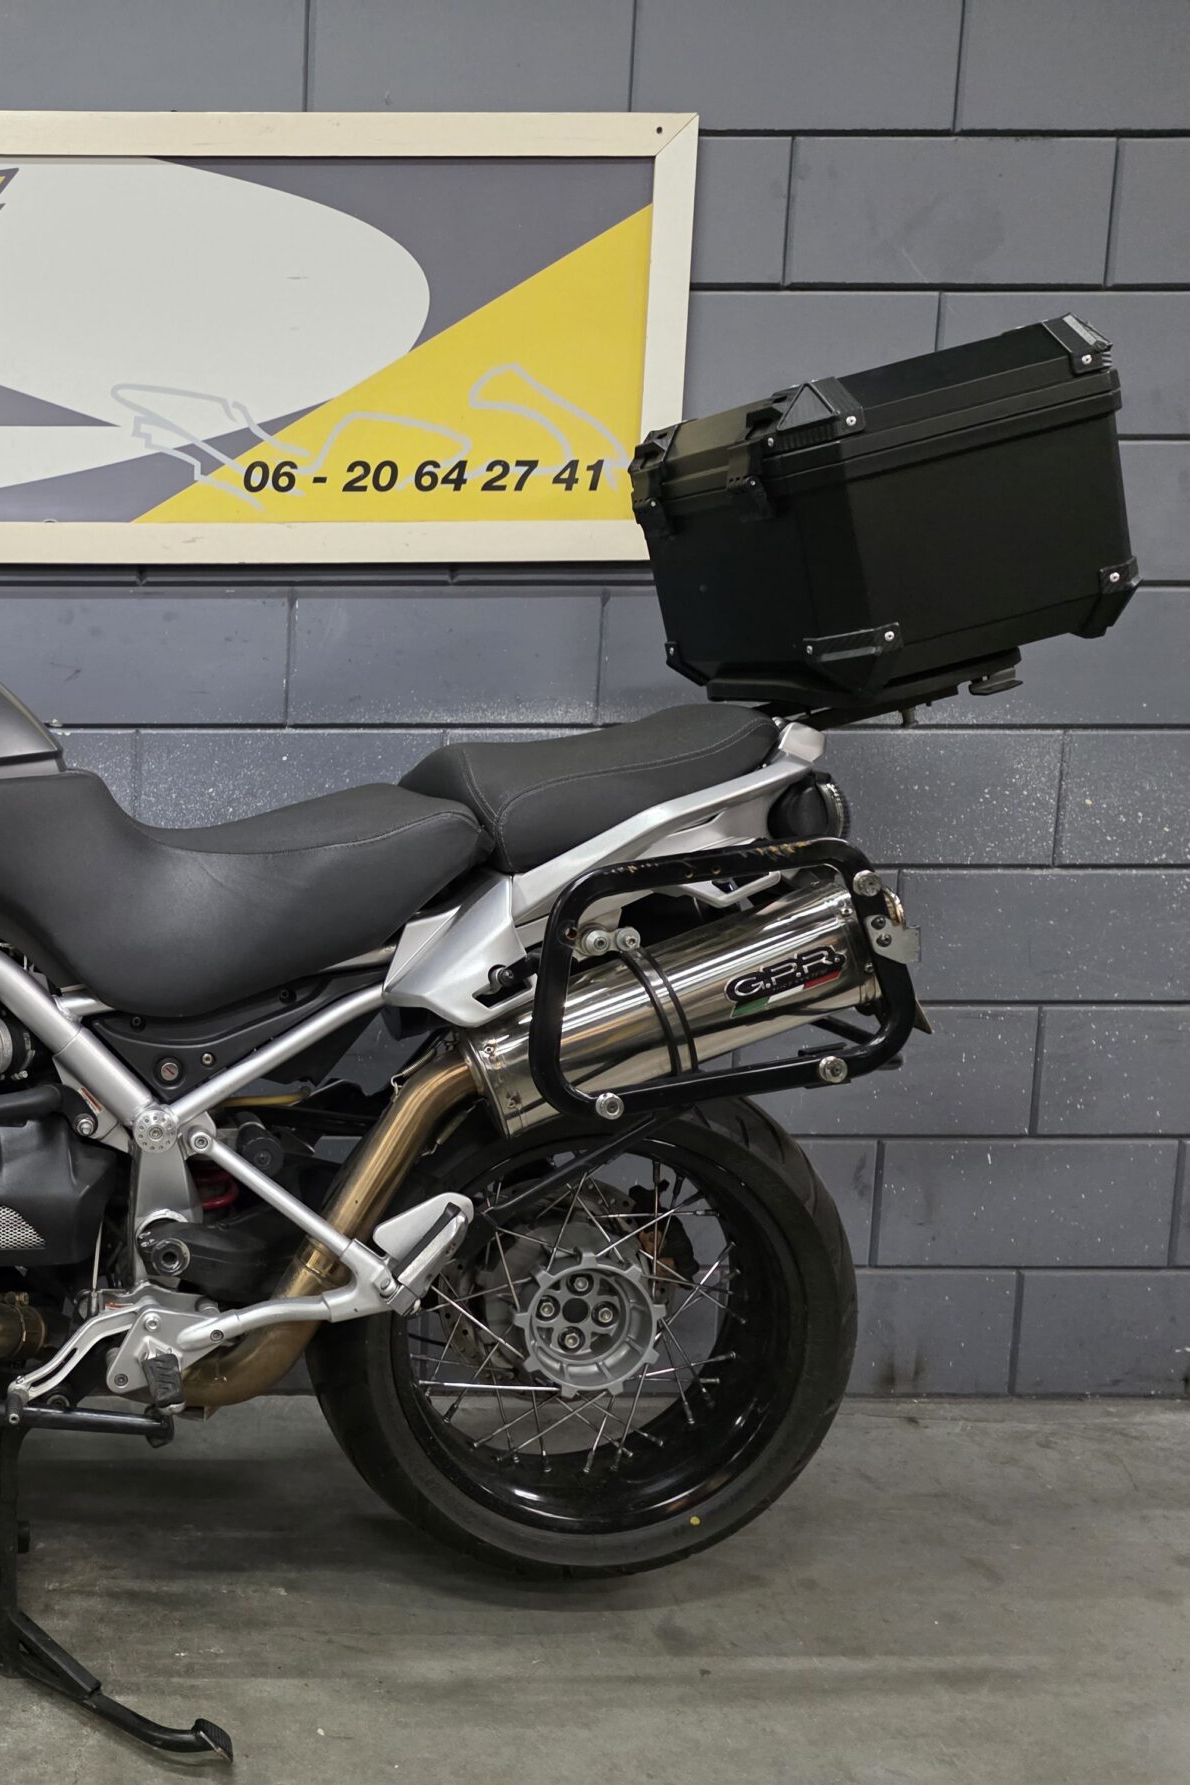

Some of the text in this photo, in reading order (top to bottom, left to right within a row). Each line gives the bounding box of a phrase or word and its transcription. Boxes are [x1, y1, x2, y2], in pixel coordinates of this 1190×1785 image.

[242, 459, 605, 493] 06 - 20 64 27 41
